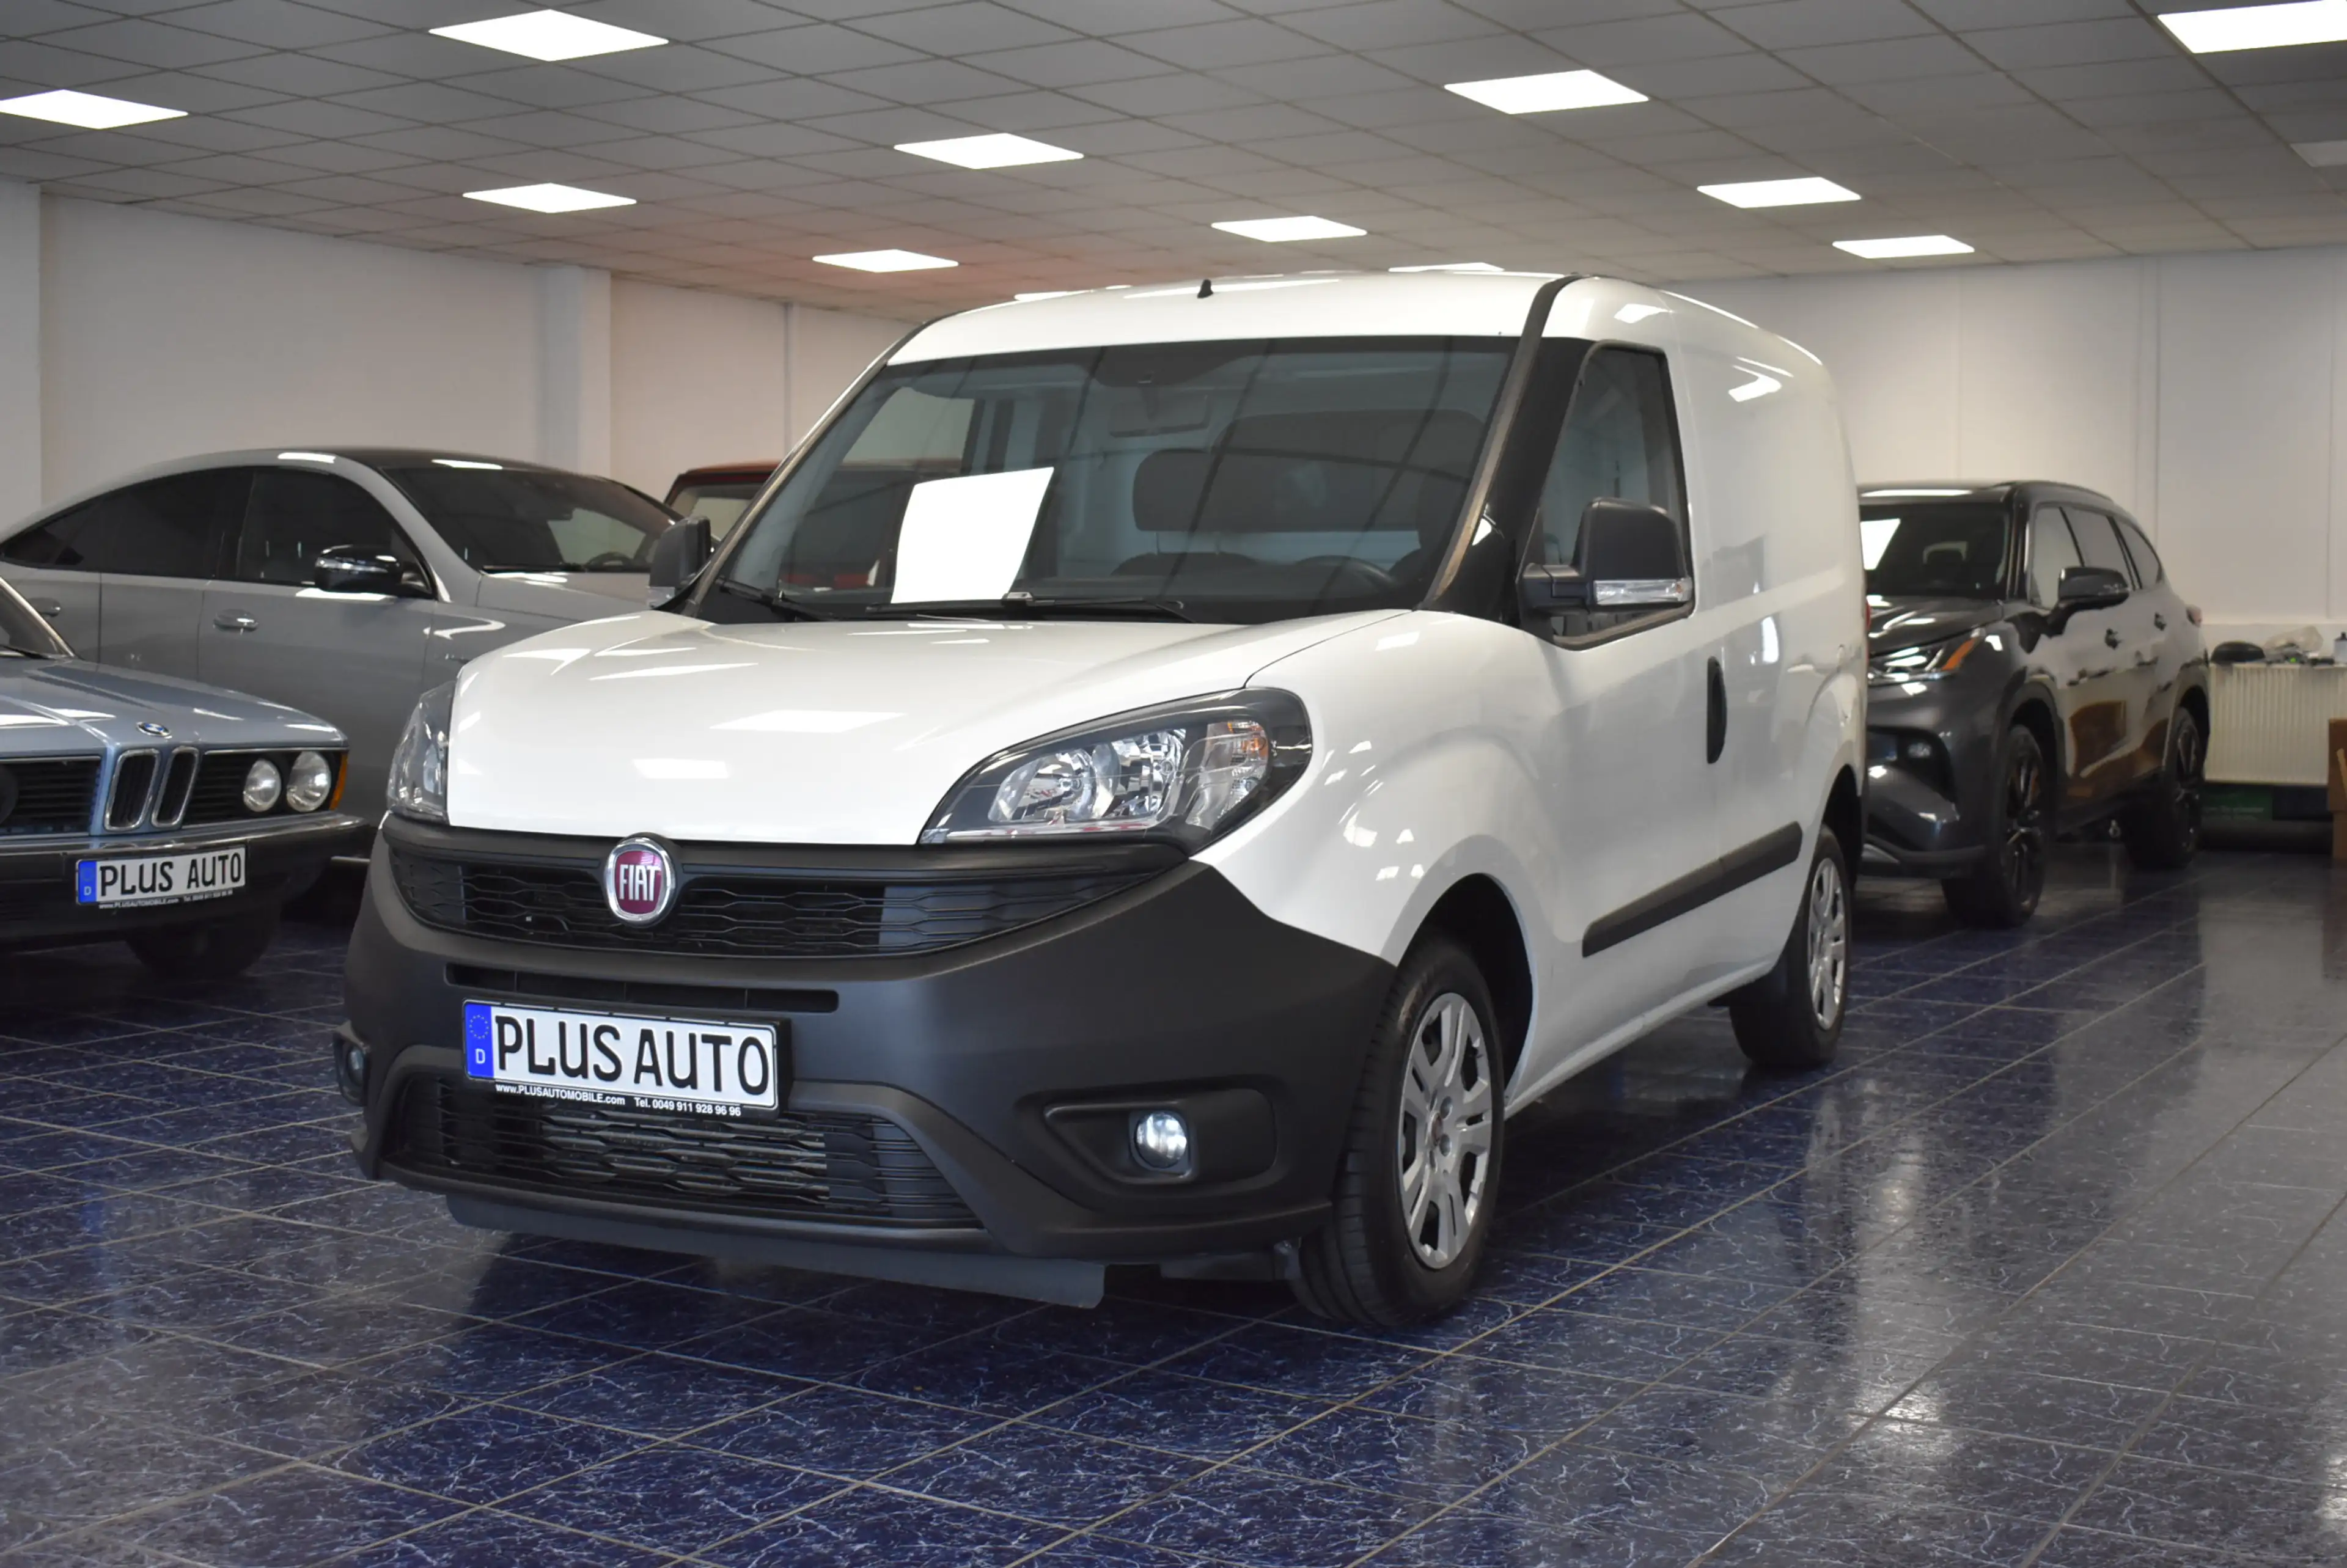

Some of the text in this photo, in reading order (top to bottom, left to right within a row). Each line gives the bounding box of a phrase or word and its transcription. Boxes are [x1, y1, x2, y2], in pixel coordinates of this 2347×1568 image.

[84, 886, 92, 896] D
[100, 852, 241, 896] PLUS AUTO
[619, 864, 661, 901] FIAT
[476, 1048, 486, 1064] D
[495, 1015, 769, 1096] PLUS AUTO
[496, 1084, 741, 1117] www.PLUSAUTOMOBILE.com Tel. 0049 911 928 96 96
